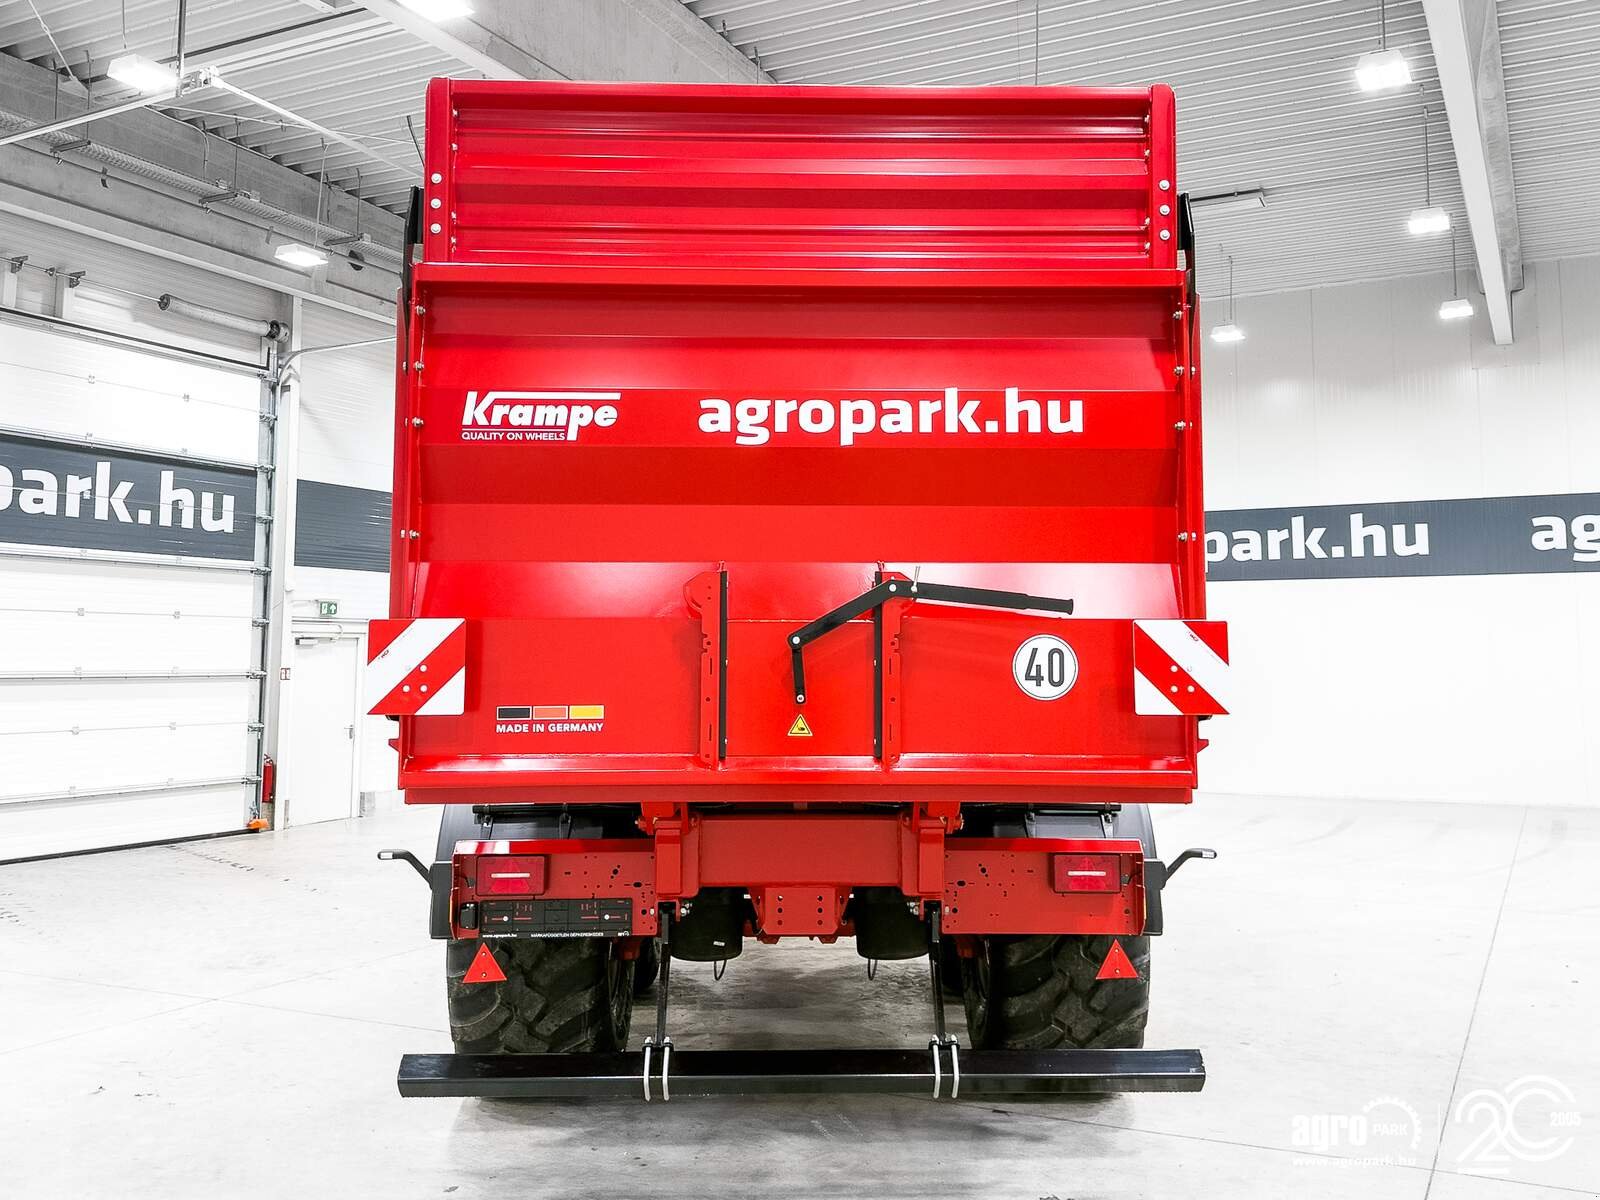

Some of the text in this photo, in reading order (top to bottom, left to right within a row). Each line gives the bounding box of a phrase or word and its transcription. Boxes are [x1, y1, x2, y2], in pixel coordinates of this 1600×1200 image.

[462, 391, 621, 441] Krampe
[699, 387, 1084, 446] agropark.hu
[461, 432, 566, 441] QUALITY ON WHEELS
[1025, 647, 1065, 687] 40
[496, 723, 604, 733] MADE IN GERMANY
